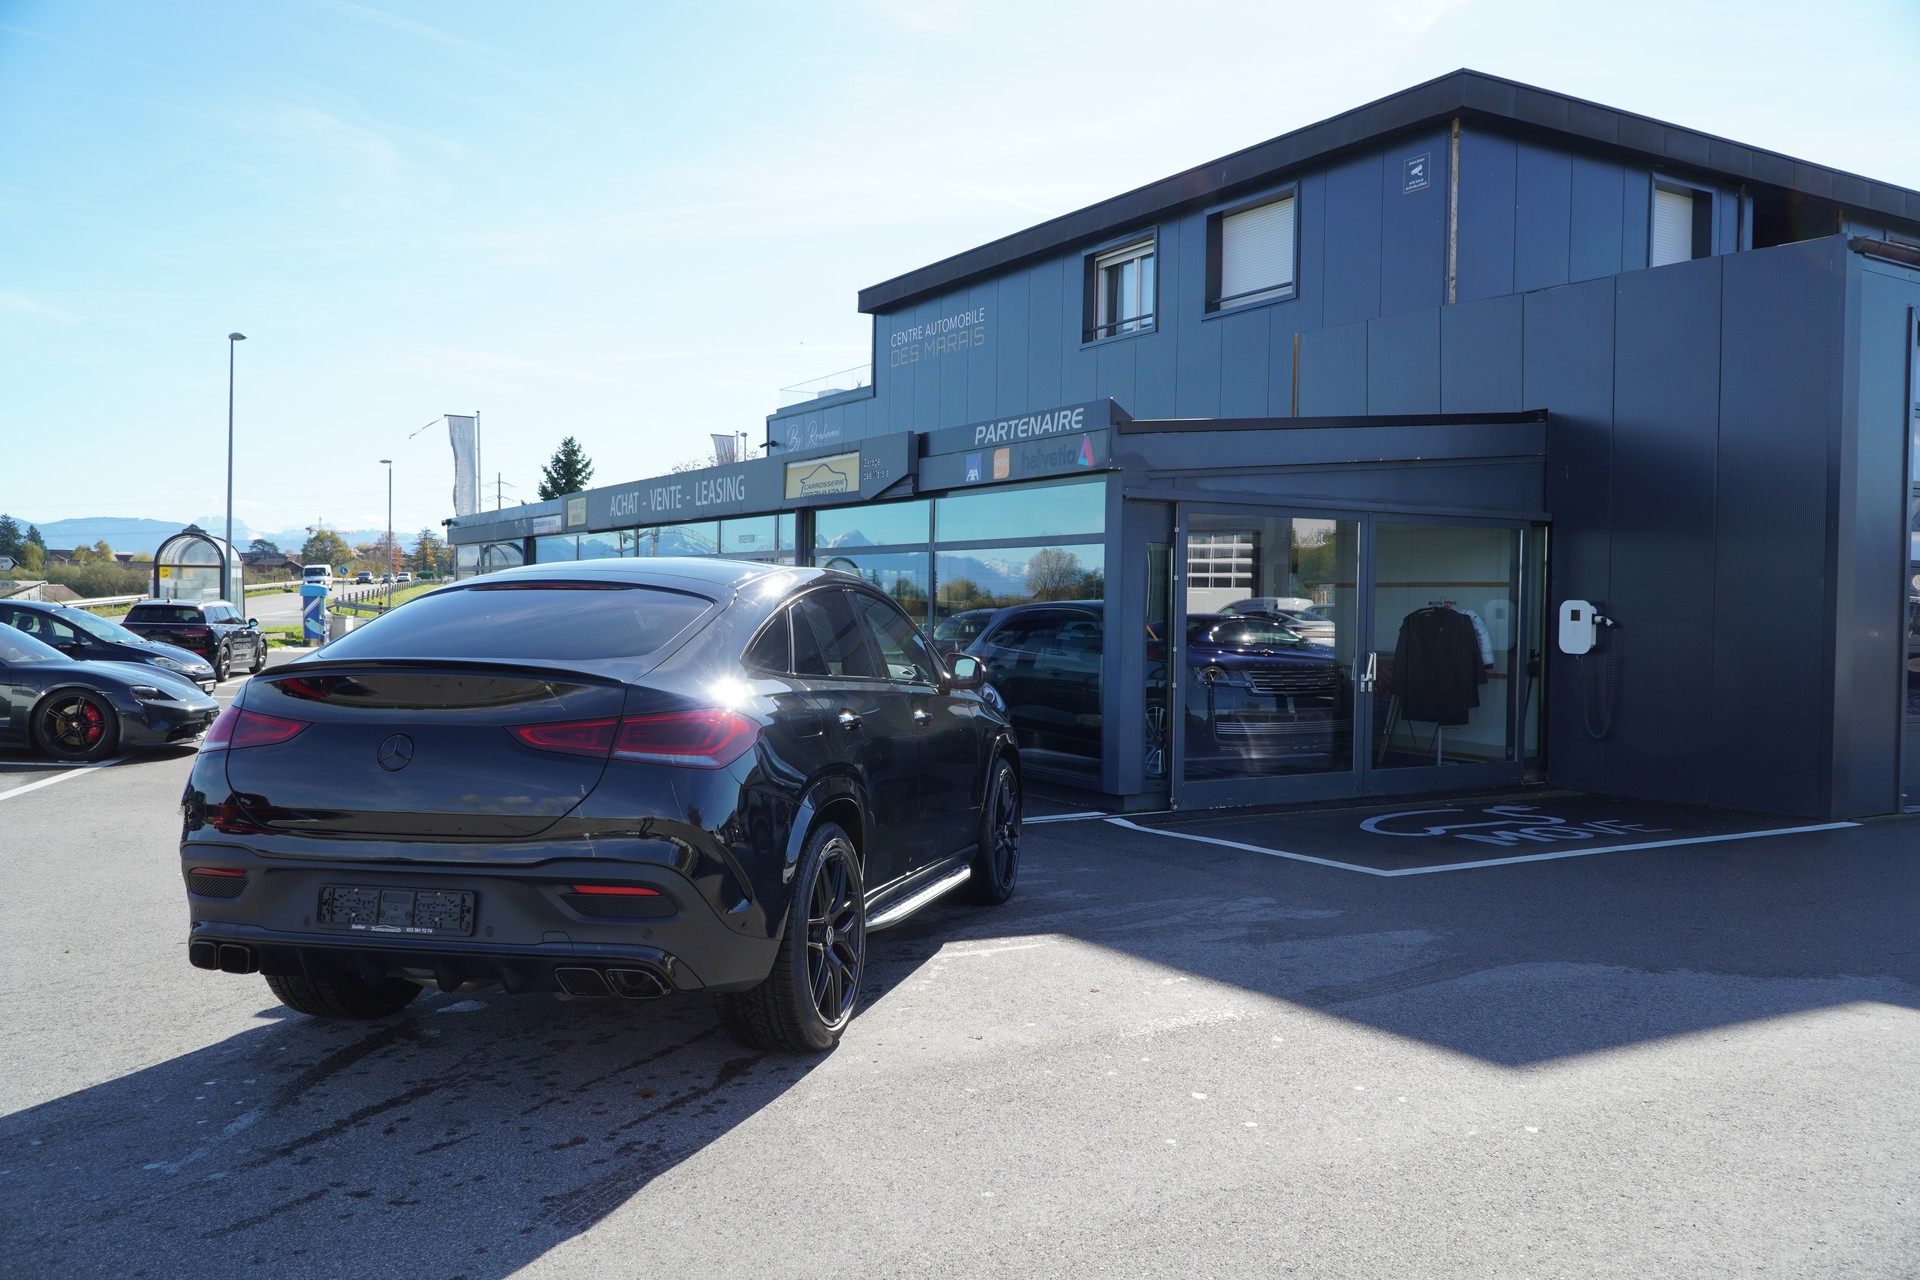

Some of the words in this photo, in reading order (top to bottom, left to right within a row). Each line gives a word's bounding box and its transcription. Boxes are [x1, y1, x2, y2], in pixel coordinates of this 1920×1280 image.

[890, 325, 923, 347] CENTRE
[924, 307, 985, 338] AUTOMOBILE
[890, 344, 919, 368] DES
[924, 326, 985, 359] MARAIS
[974, 407, 1085, 445] PARTENAIRE
[1021, 444, 1076, 471] helvetia
[609, 491, 640, 517] ACHAT
[649, 485, 682, 512] VENTE
[695, 474, 745, 506] LEASING
[803, 479, 844, 491] CARROSSERIE
[1454, 819, 1673, 847] MOVE
